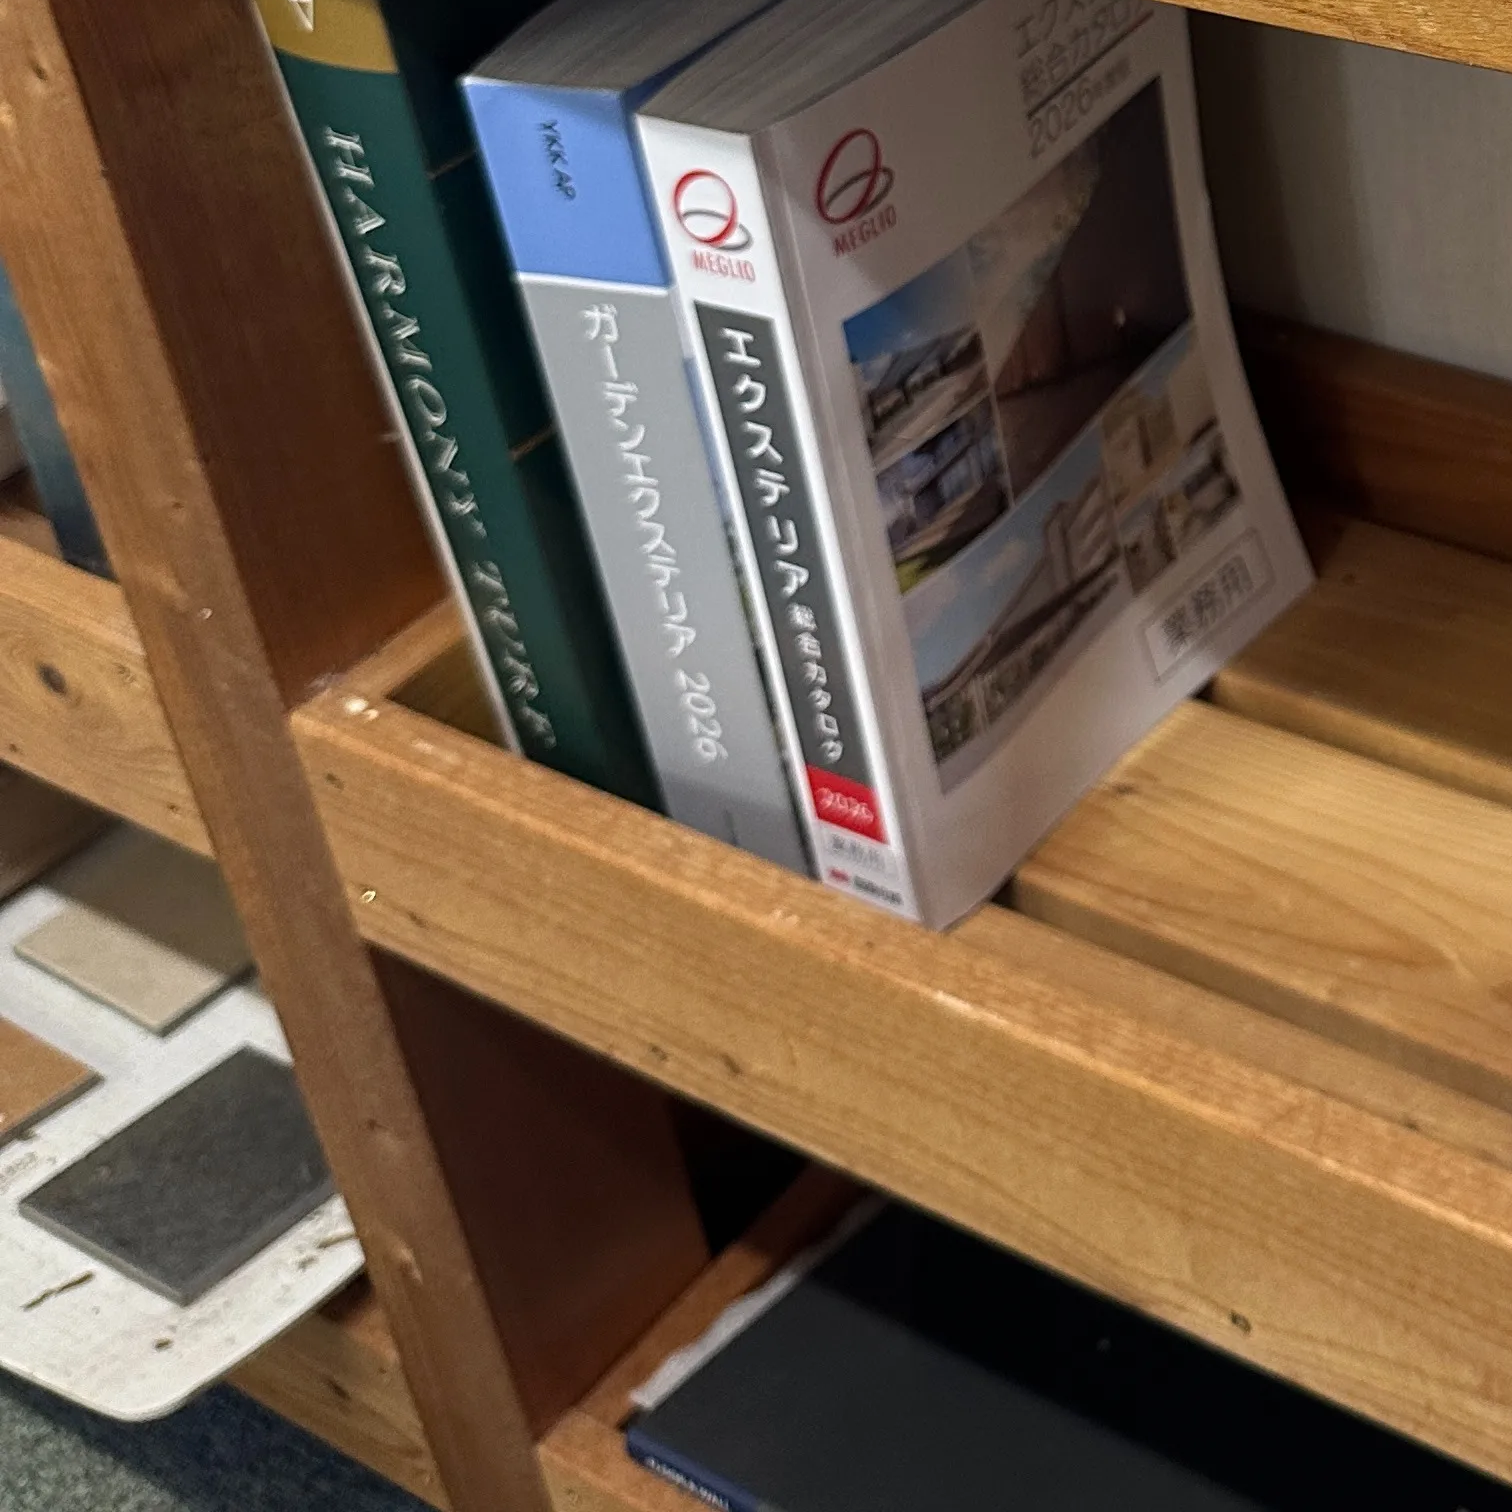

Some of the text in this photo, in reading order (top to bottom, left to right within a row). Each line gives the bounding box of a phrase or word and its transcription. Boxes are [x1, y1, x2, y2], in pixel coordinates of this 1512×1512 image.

[320, 125, 488, 538] HARMONY
[691, 248, 757, 285] MEGLIO
[833, 205, 898, 258] MEGLIO
[581, 302, 729, 765] ガーデンエクステリア 2026
